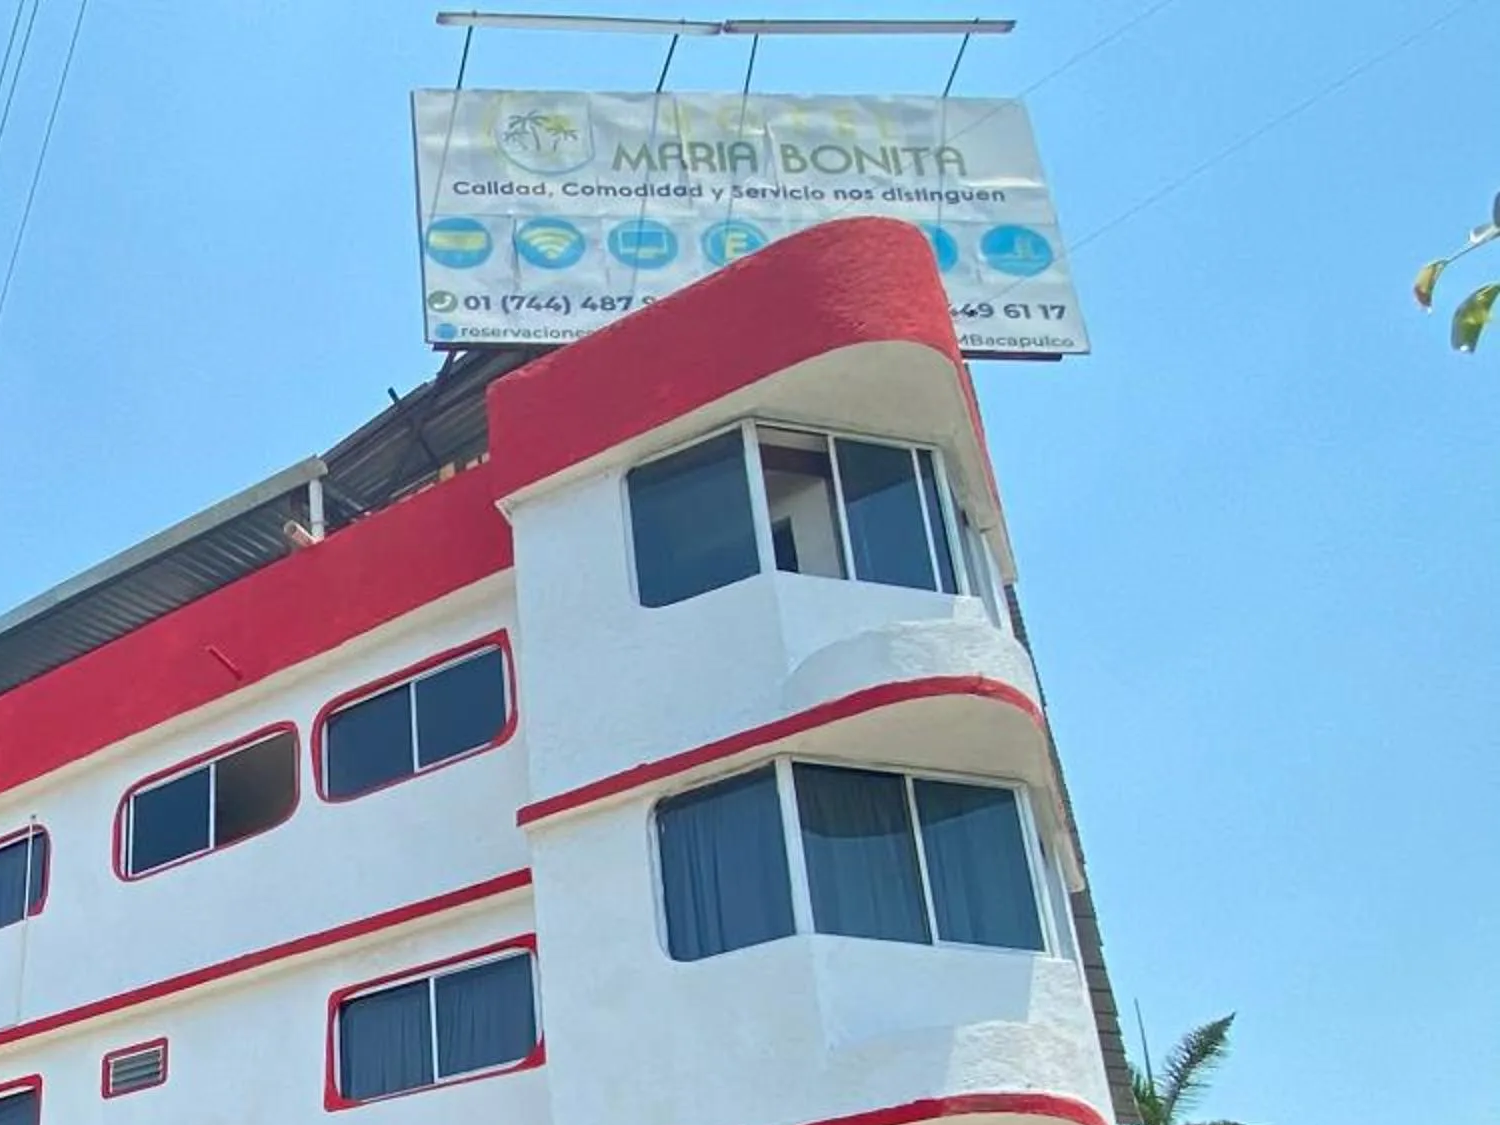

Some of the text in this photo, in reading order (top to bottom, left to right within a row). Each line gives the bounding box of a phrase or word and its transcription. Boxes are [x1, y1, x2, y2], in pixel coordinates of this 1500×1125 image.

[611, 141, 967, 177] MARIA BONITA
[452, 181, 1006, 204] Calidad, Comodidad y Servicio nos distinguen
[463, 295, 491, 311] 01
[501, 295, 571, 315] (744)
[580, 295, 634, 312] 487
[1003, 303, 1031, 319] 61
[1038, 304, 1066, 320] 17
